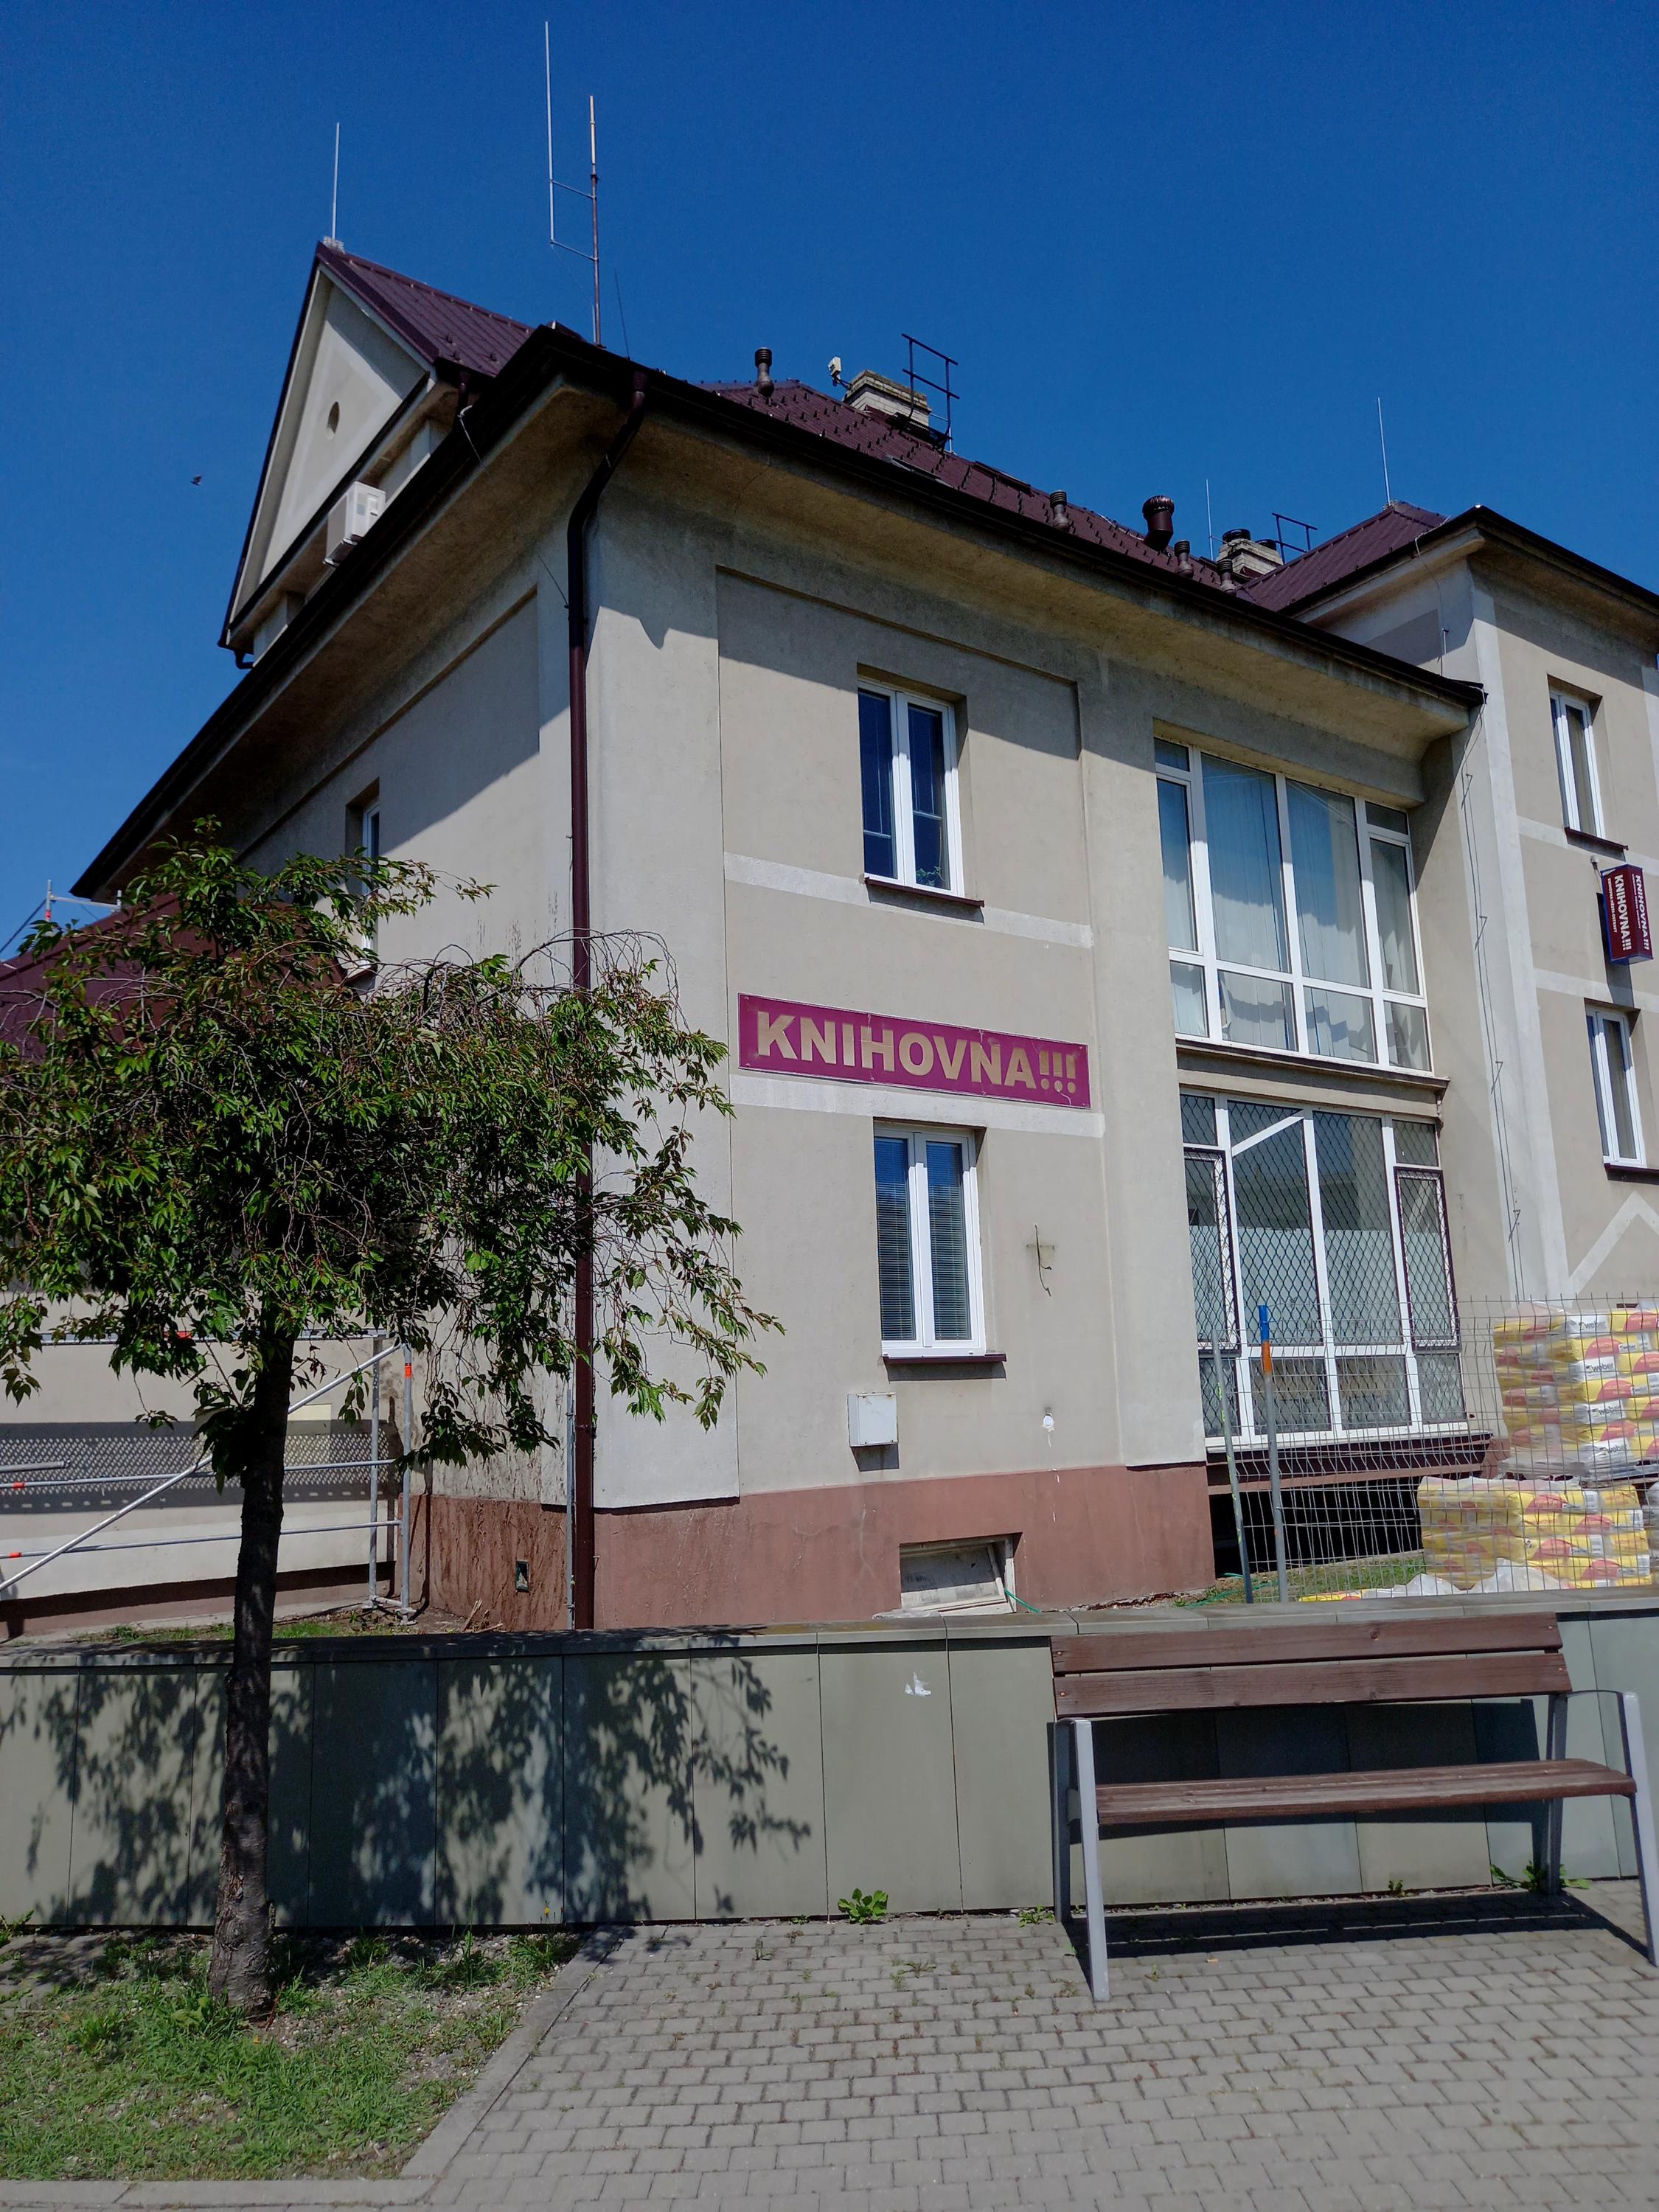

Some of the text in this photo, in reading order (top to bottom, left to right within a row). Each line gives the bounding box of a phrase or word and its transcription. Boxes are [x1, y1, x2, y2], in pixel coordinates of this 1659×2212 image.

[1615, 874, 1632, 950] KNIHOVNA!!!
[757, 1010, 1077, 1094] KNIHOVNA!!!
[1591, 1363, 1613, 1371] weber
